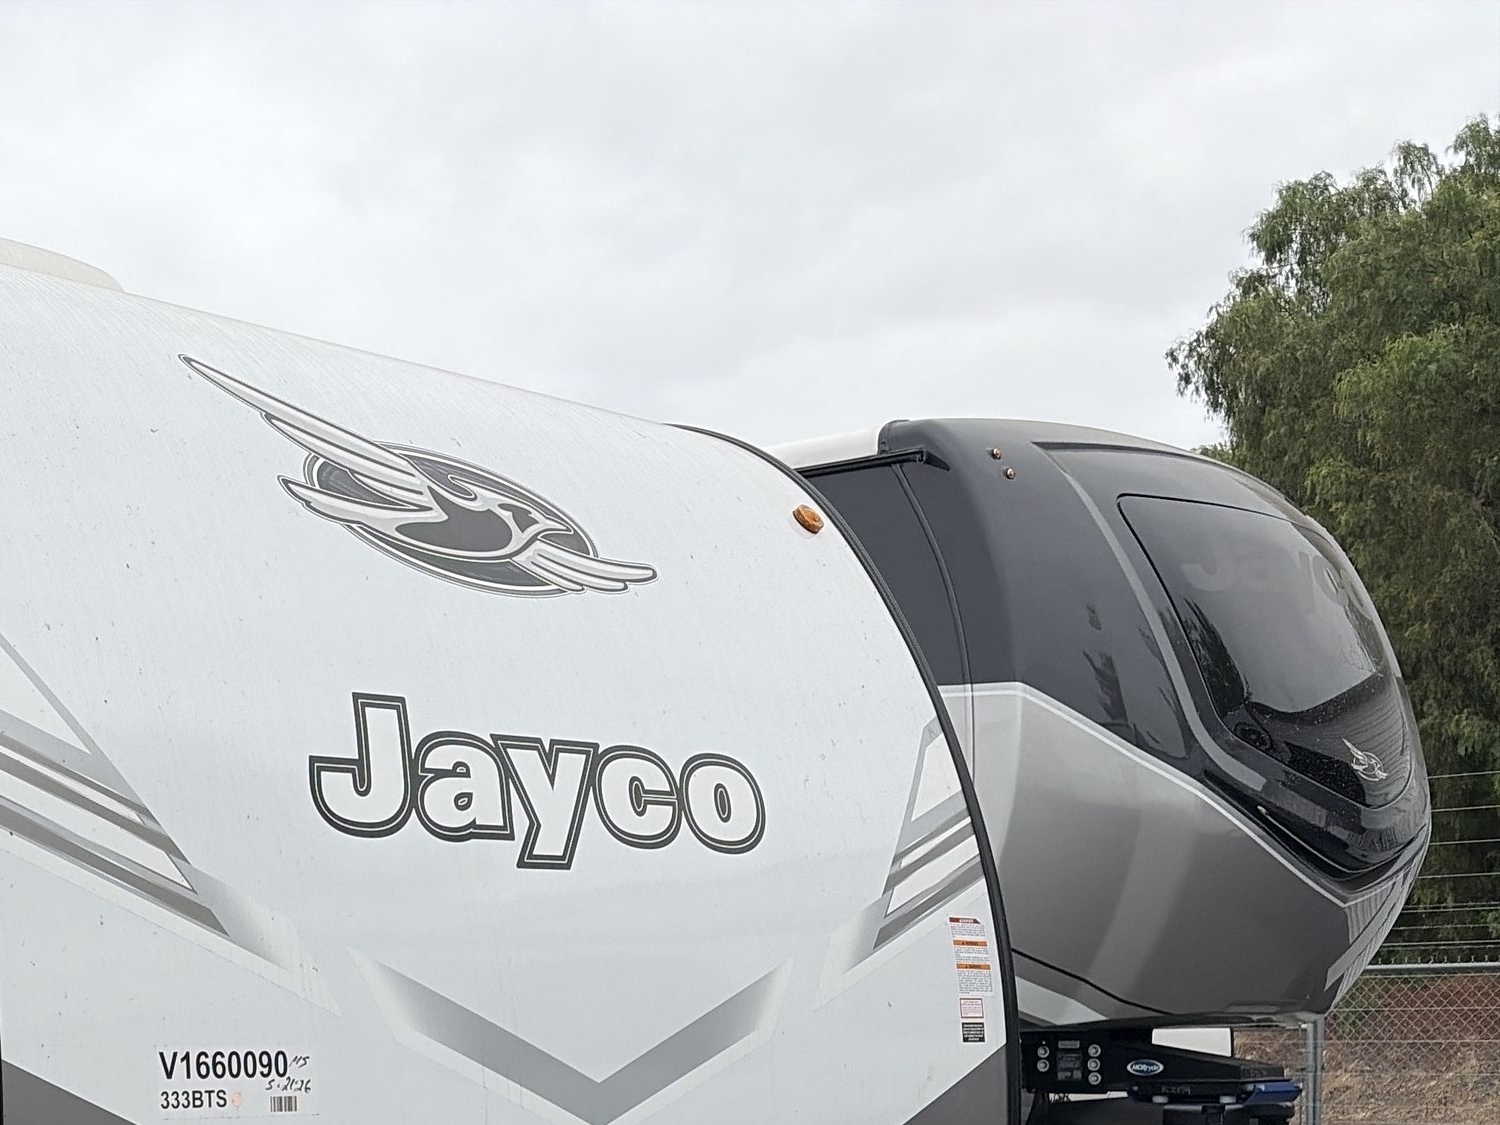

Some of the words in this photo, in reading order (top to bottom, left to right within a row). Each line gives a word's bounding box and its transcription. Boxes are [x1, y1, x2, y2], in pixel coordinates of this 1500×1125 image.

[308, 691, 767, 870] Jayco
[158, 1050, 288, 1079] V1660090
[160, 1089, 227, 1109] 333BTS
